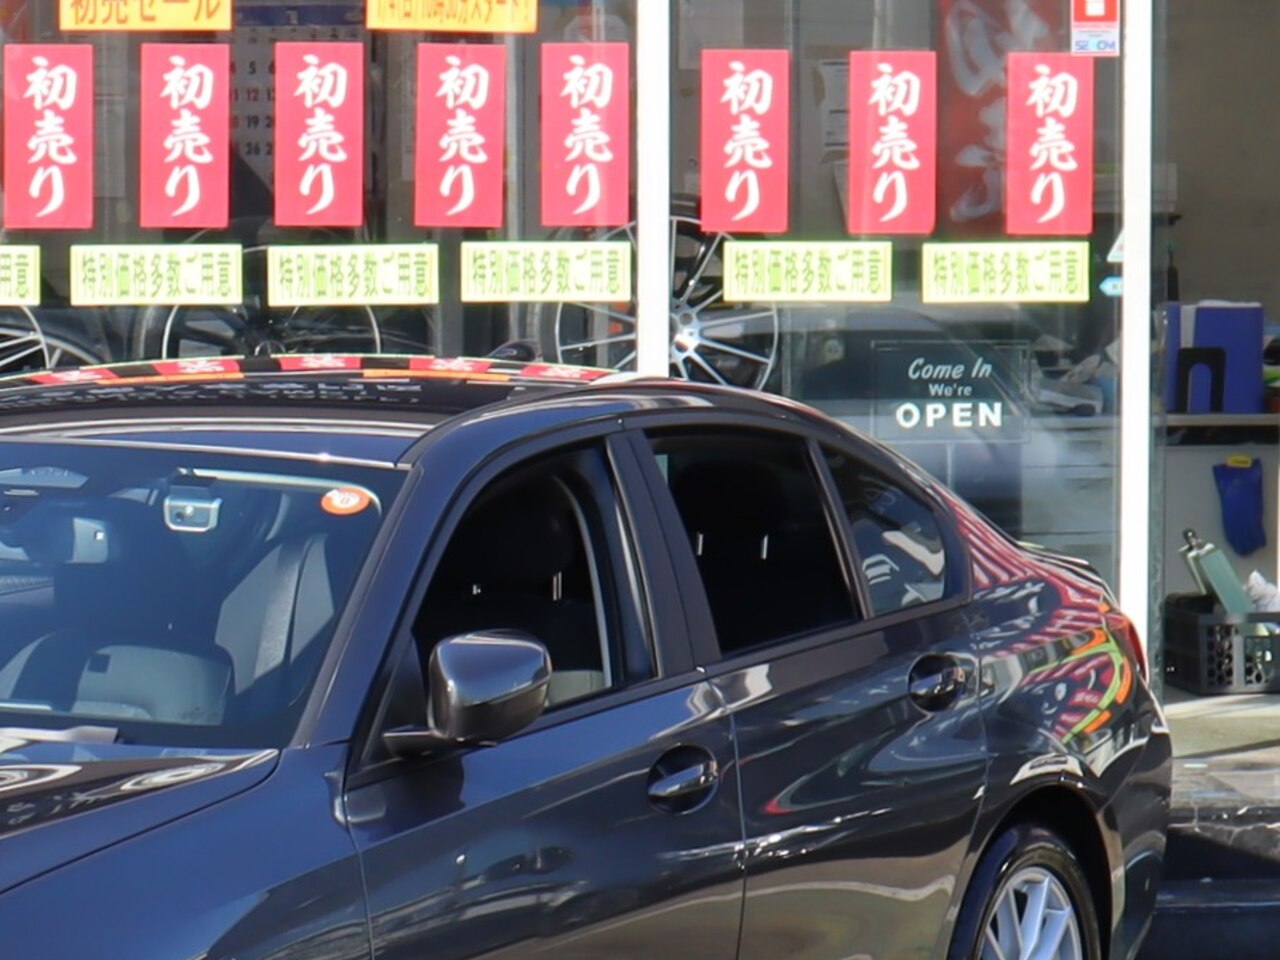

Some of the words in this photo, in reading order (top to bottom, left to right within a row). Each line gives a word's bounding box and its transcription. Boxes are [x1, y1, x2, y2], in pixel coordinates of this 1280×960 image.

[1075, 40, 1116, 50] SEOM
[24, 56, 78, 217] 初売り
[161, 55, 214, 216] 初売り
[294, 54, 348, 214] 初売り
[436, 55, 490, 215] 初売り
[561, 54, 614, 214] 初売り
[721, 61, 773, 220] 初売り
[868, 62, 921, 222] 初売り
[1027, 64, 1078, 223] 初売り
[82, 252, 234, 298] 特別価格多数ご用意
[279, 253, 431, 299] 特別価格多数ご用意
[472, 250, 623, 296] 特別価格多数ご用意
[734, 249, 882, 294] 特別価格多数ご用意
[932, 248, 1082, 294] 特別価格多数ご用意
[908, 357, 966, 380] Come
[971, 357, 993, 379] In
[928, 383, 972, 397] We're
[896, 402, 1003, 429] OPEN
